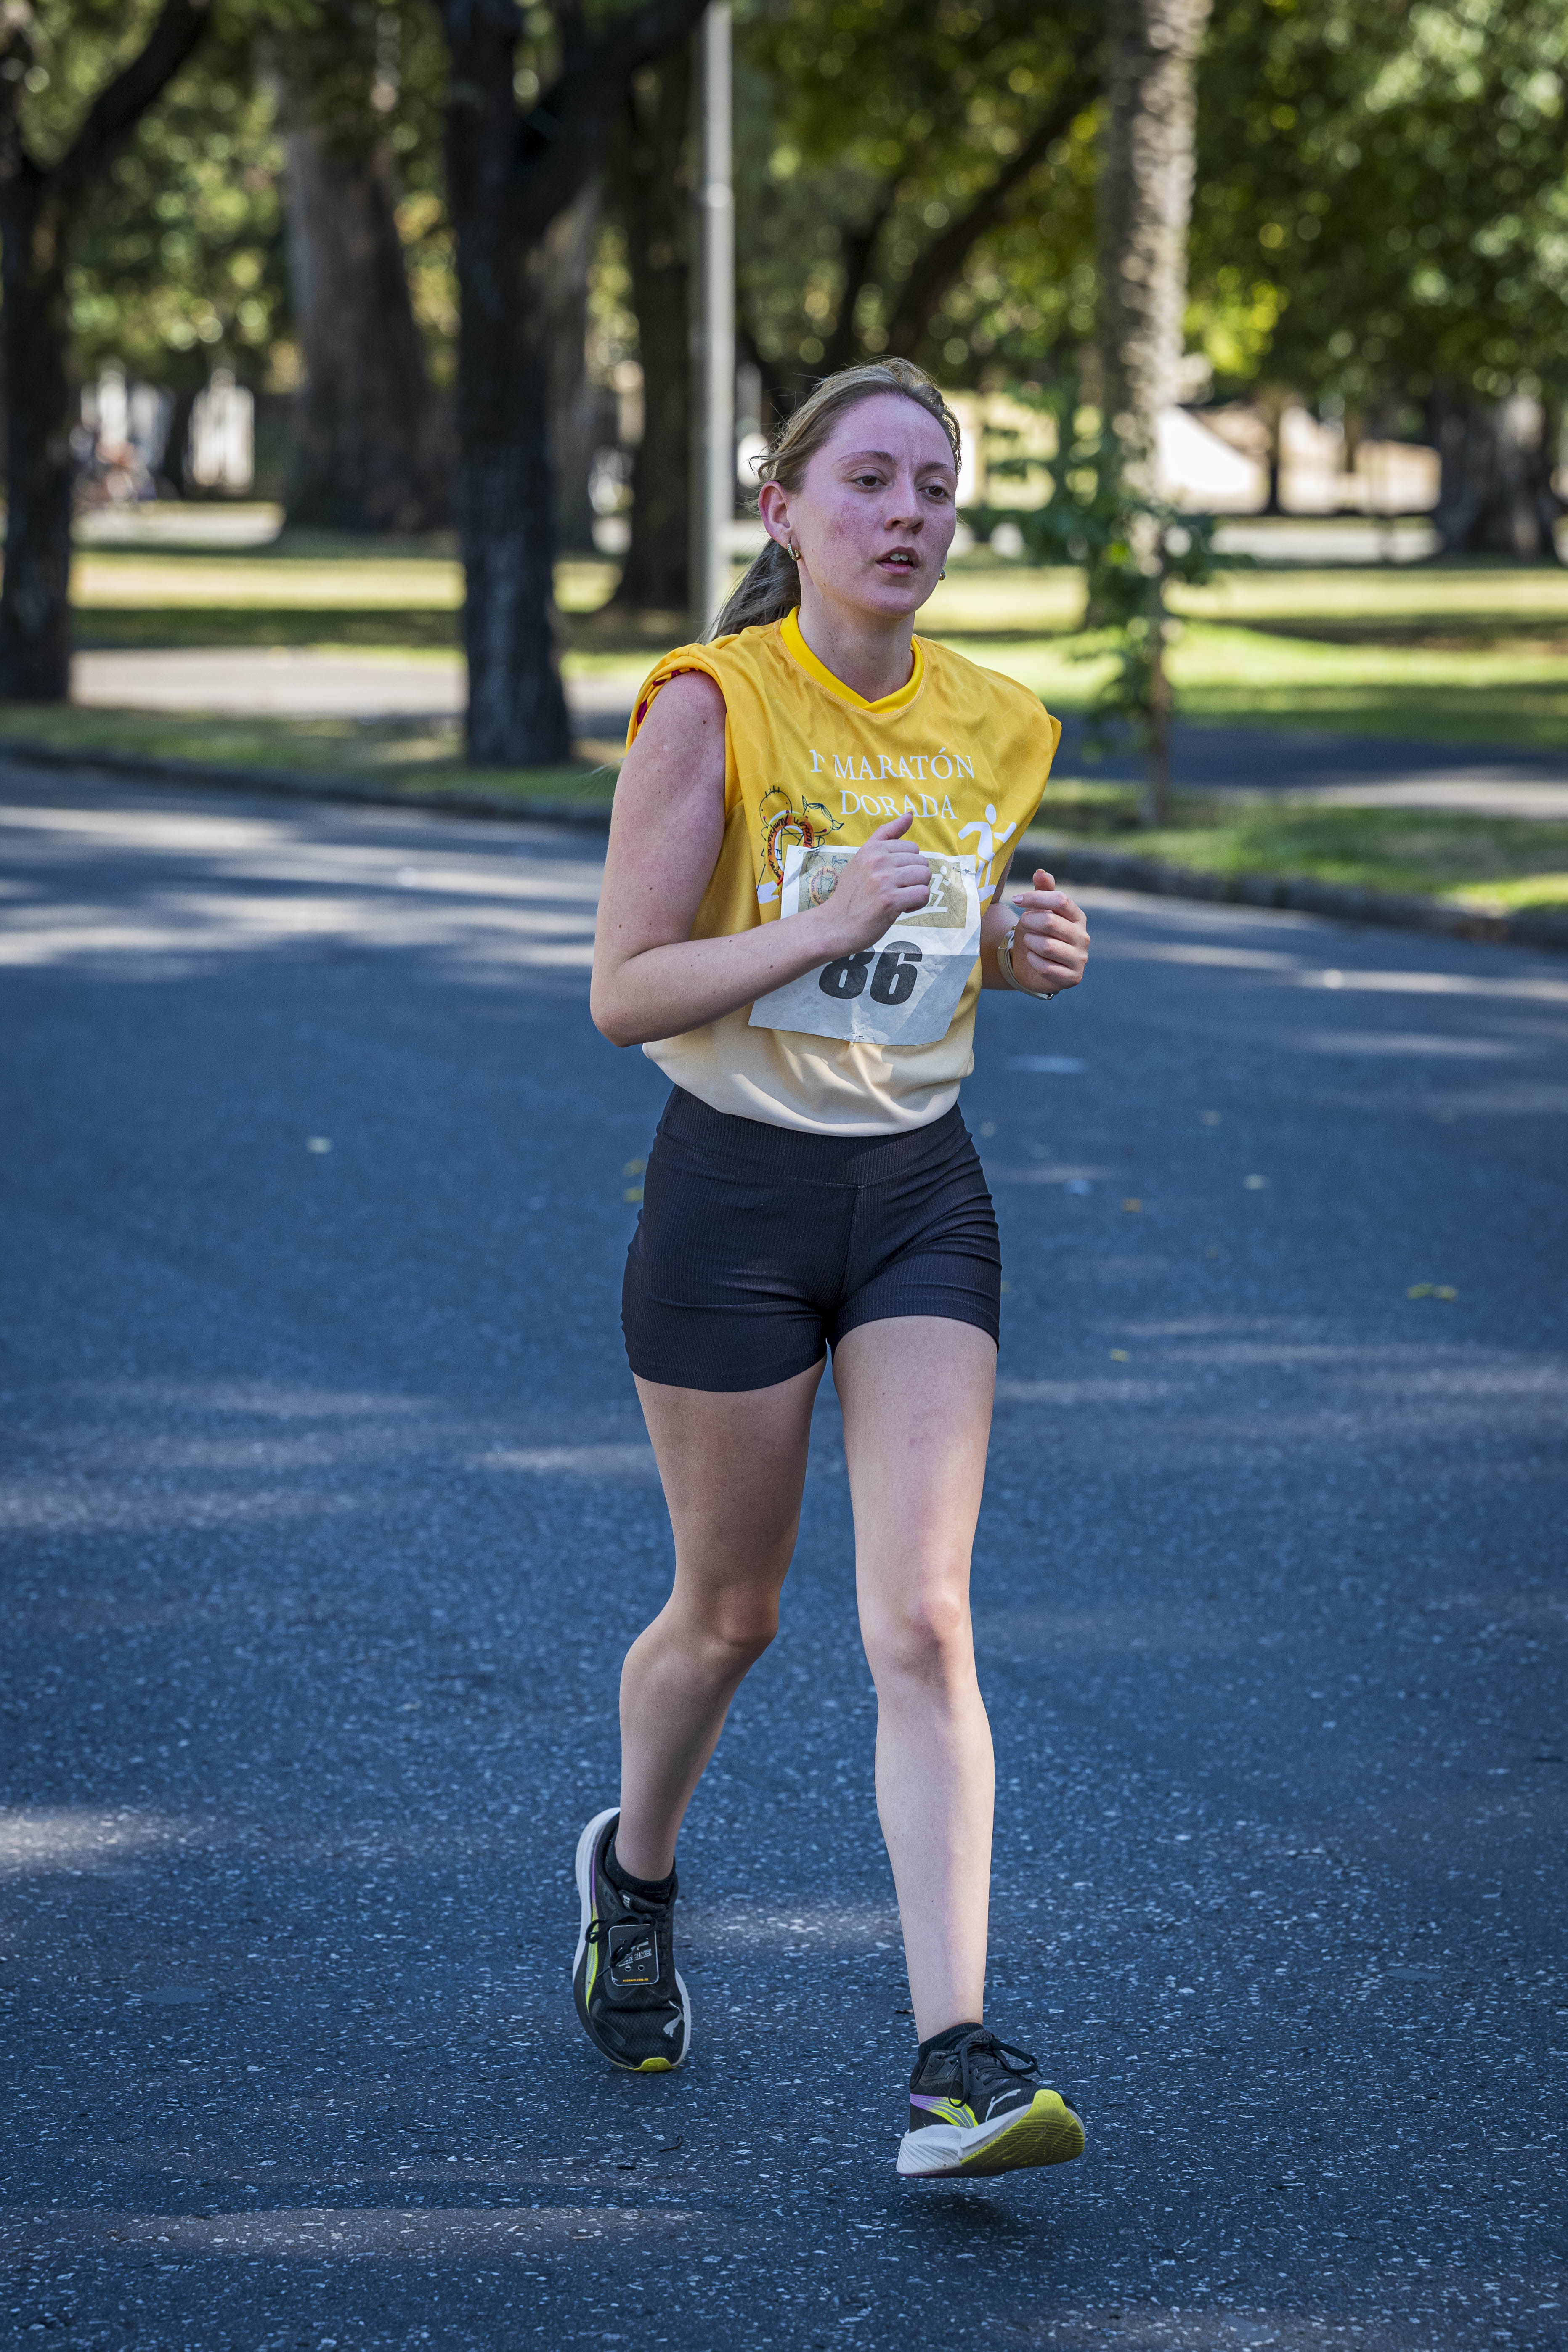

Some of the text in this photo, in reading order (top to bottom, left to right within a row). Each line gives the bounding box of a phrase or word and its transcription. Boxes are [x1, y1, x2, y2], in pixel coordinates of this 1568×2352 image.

[832, 747, 974, 780] MARATÓN
[840, 790, 958, 819] DORADA
[818, 941, 923, 1005] 86
